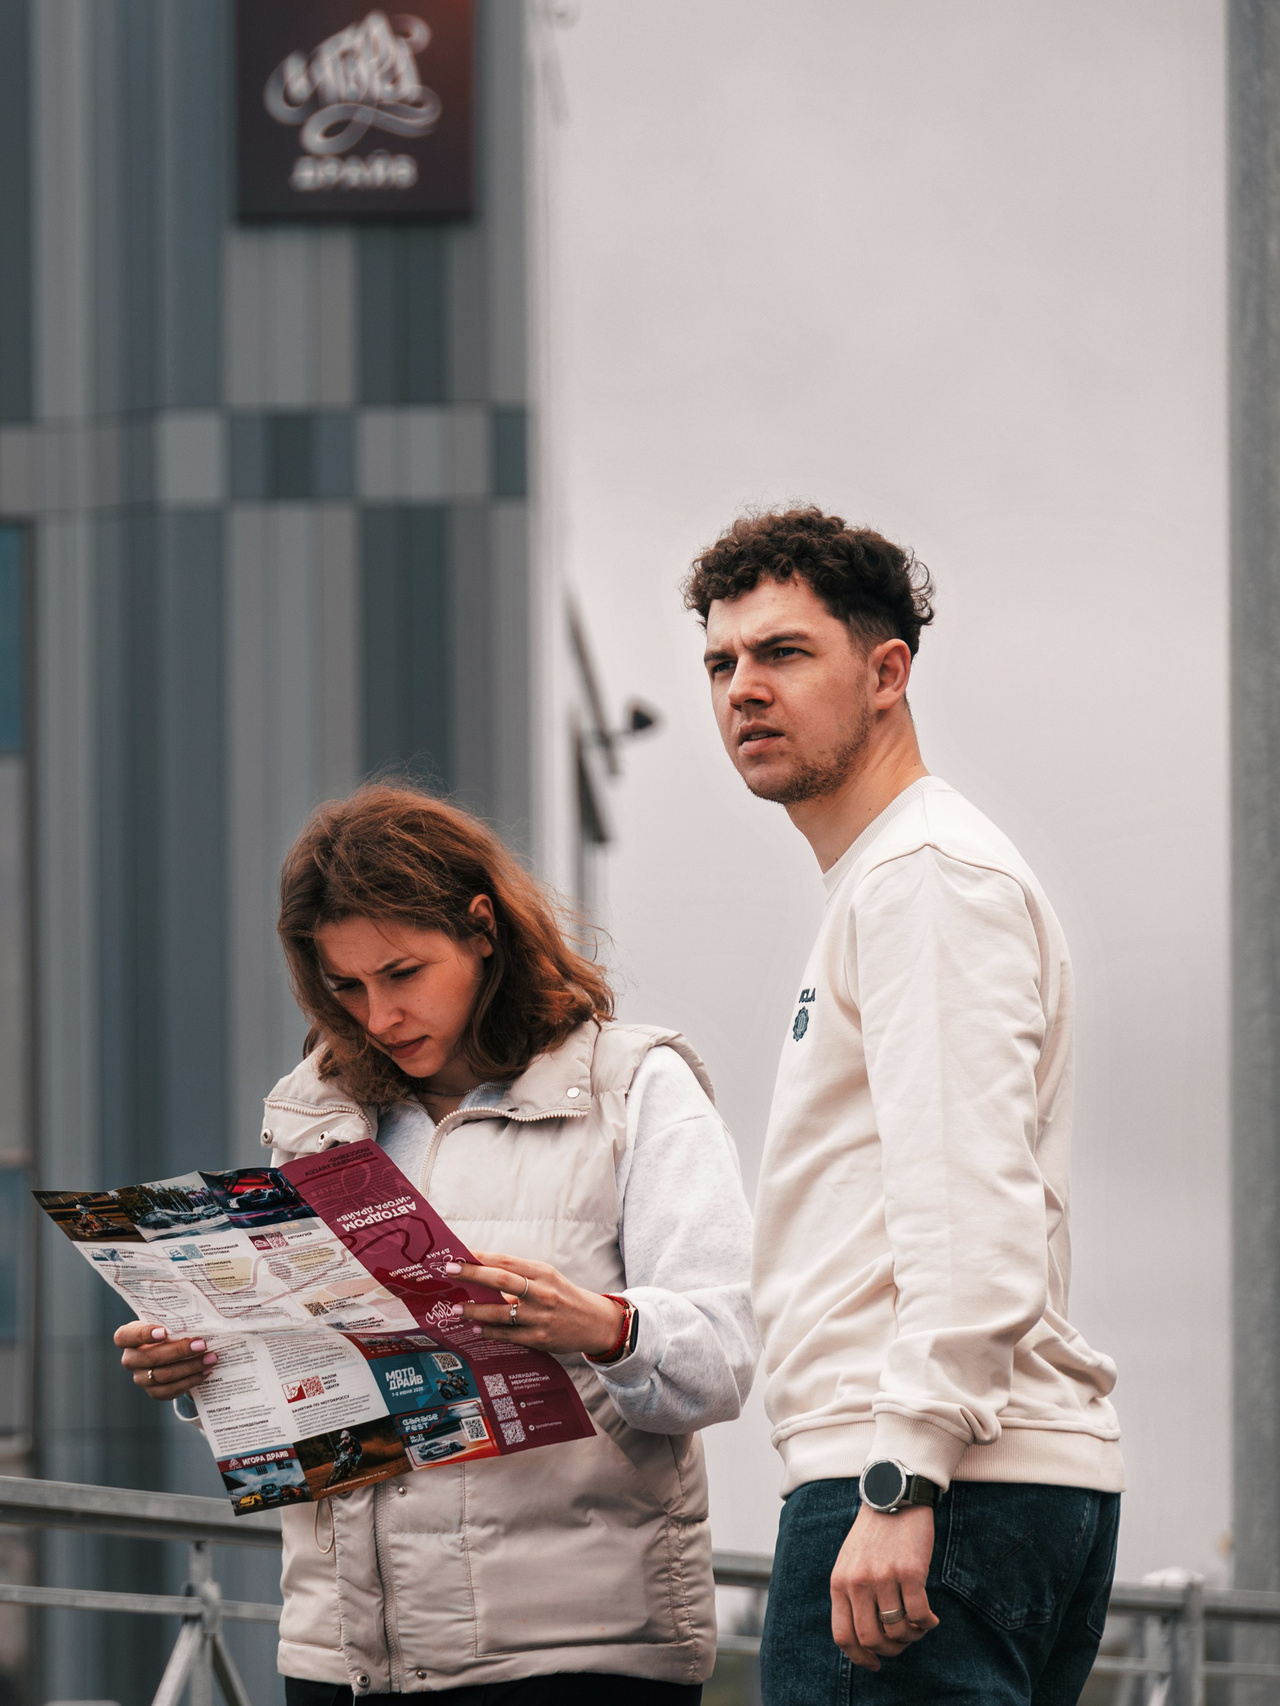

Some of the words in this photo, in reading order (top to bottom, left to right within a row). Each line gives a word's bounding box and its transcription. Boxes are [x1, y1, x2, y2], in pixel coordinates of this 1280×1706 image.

[342, 1201, 417, 1232] АВТОДРОМ
[388, 1263, 424, 1278] ЭМОЦИЙ
[401, 1269, 428, 1280] ТВОИХ
[416, 1274, 433, 1282] МИР
[385, 1367, 415, 1382] МОТО
[241, 1455, 266, 1466] ИГОРА
